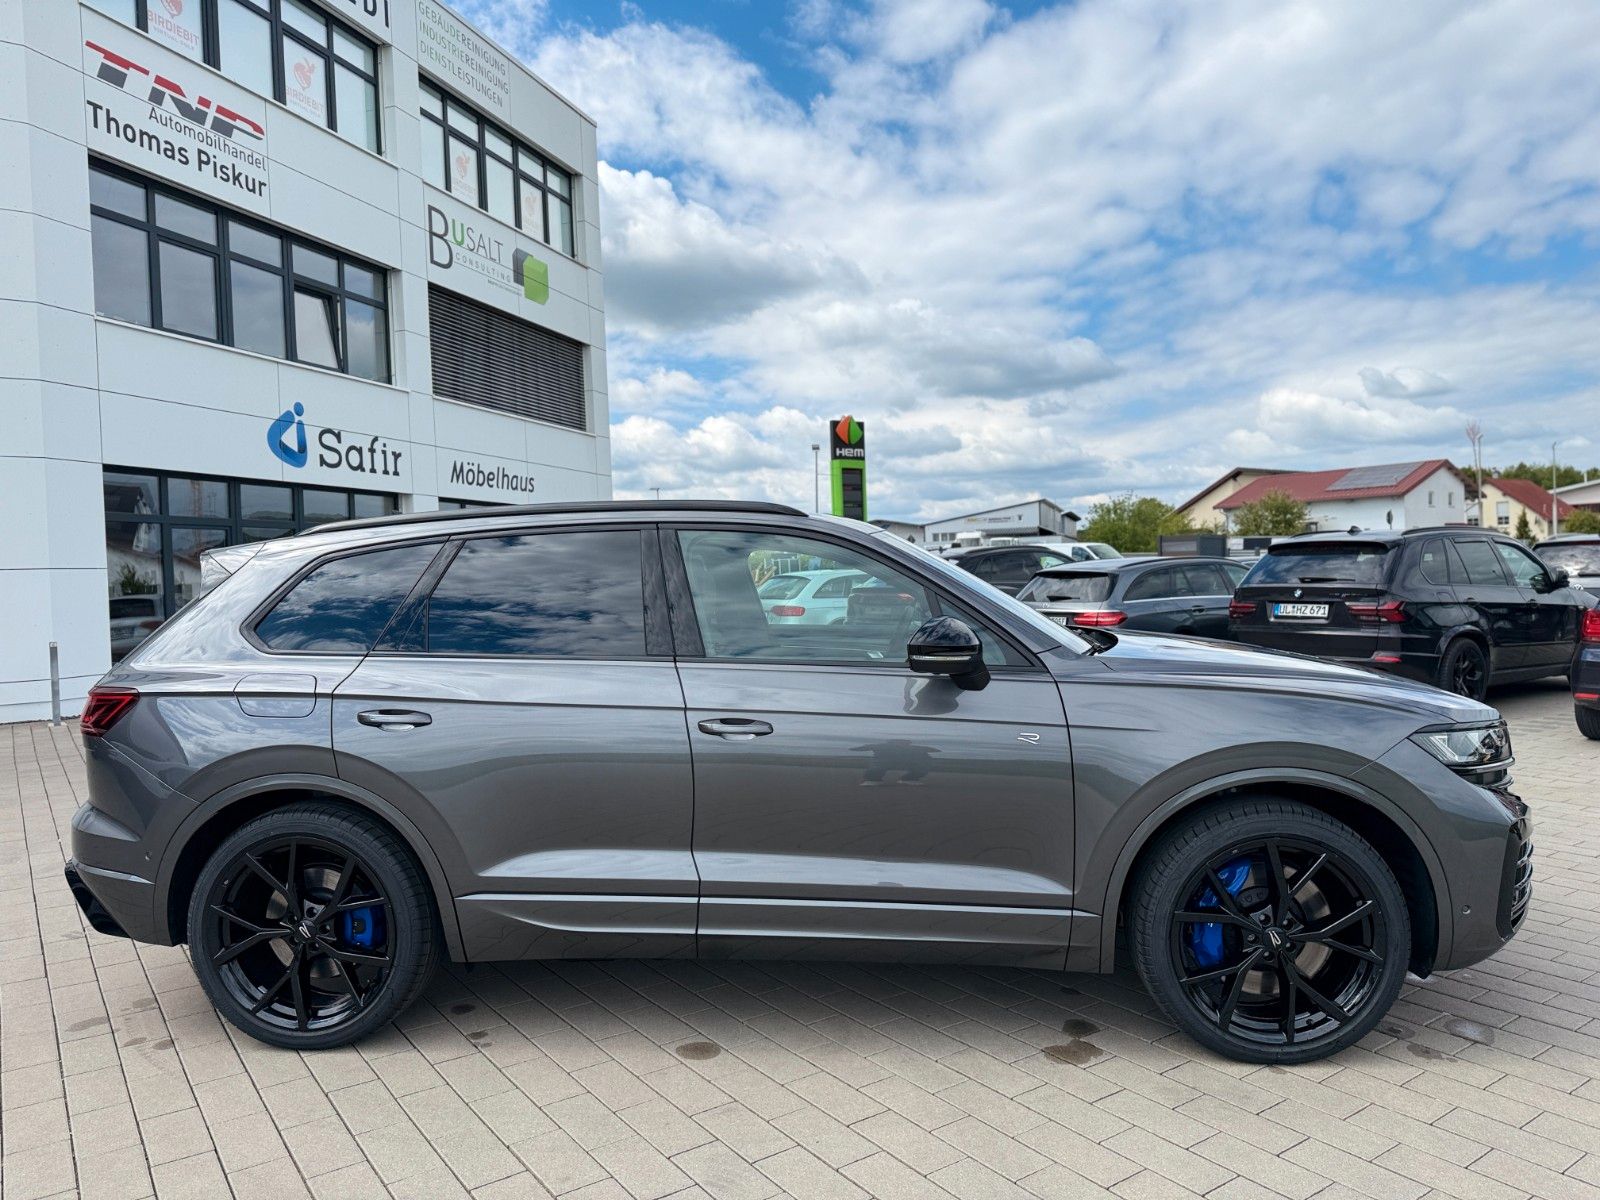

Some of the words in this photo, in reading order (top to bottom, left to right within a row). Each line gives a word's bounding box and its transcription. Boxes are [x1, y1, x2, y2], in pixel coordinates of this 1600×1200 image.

[418, 2, 506, 75] GEBÄUDEREINIGUNG
[419, 21, 509, 95] INDUSTRIEREINIGUNG
[420, 40, 503, 107] DIENSTLEISTUNGEN
[86, 100, 190, 166] Thomas
[197, 148, 267, 197] Piskur
[149, 107, 267, 172] Automobilhandel
[428, 204, 504, 269] BUSALT
[455, 252, 511, 283] CONSULTING
[318, 428, 402, 477] Safir
[450, 460, 535, 493] Möbelhaus
[1309, 605, 1328, 616] 671
